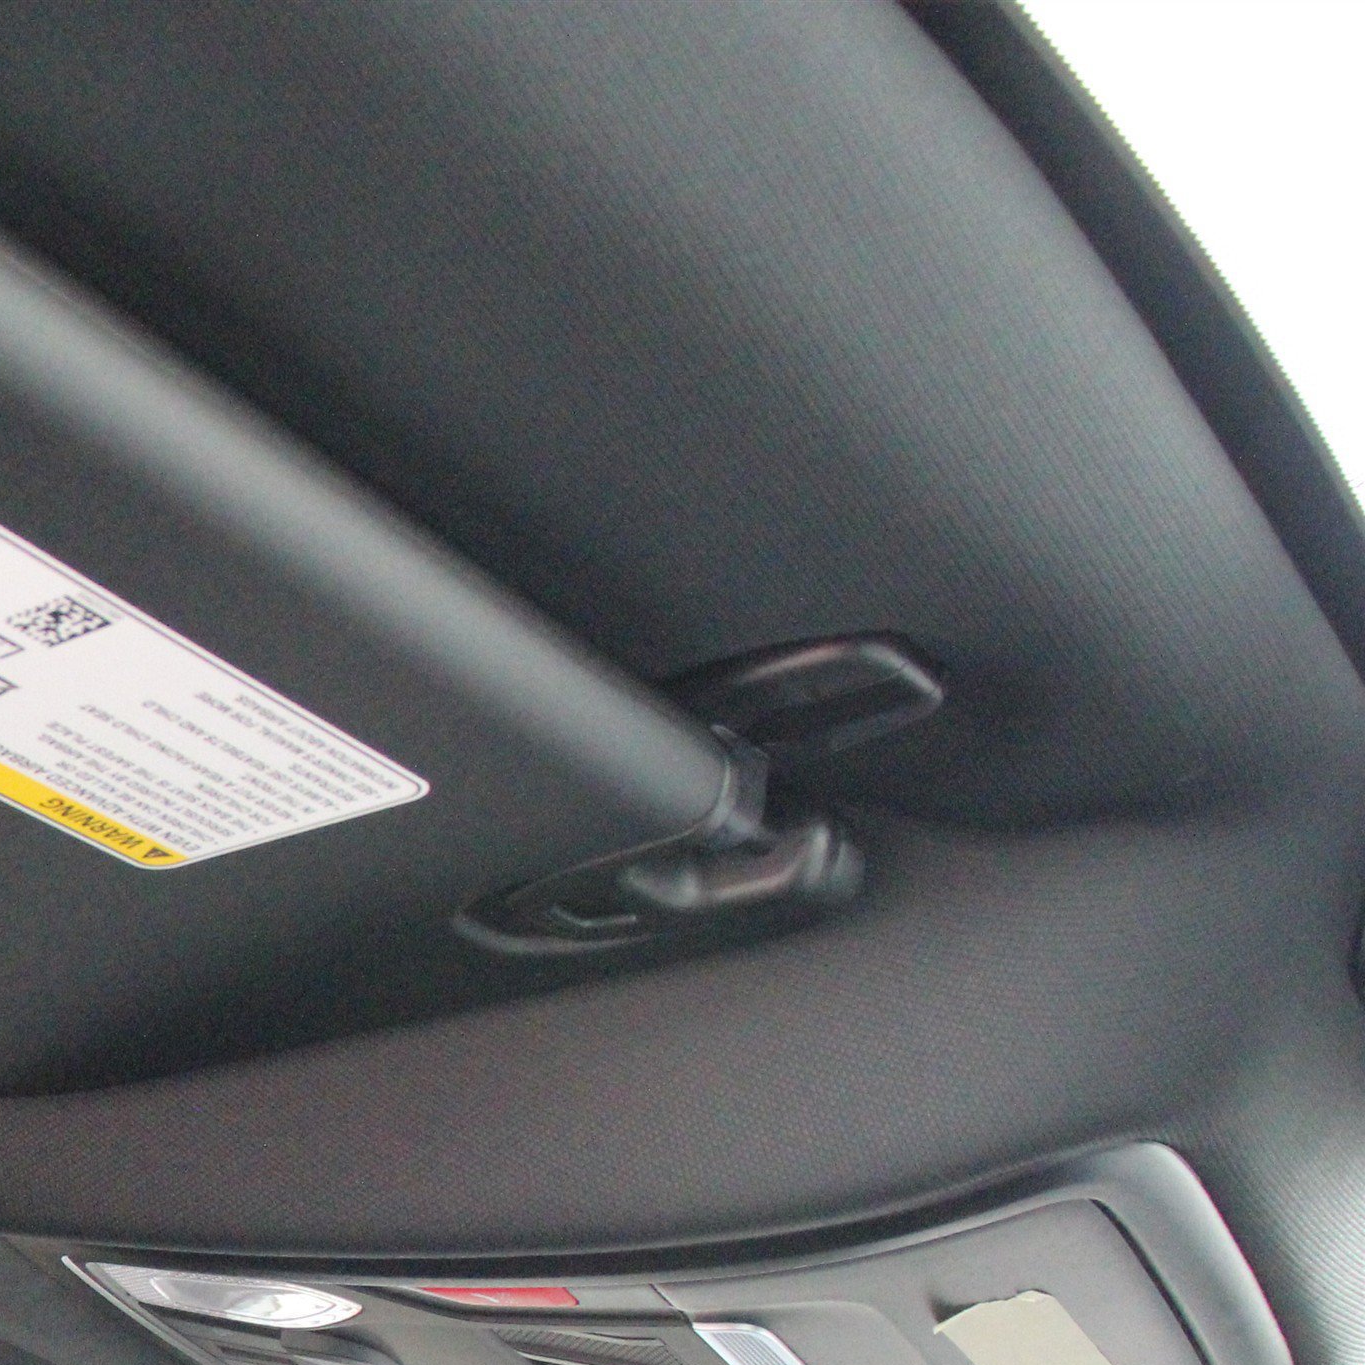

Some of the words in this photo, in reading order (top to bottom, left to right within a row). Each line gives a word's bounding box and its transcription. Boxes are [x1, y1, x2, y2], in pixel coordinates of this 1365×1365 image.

[45, 774, 128, 813] ADVANCED
[41, 797, 145, 846] WARNING
[123, 813, 165, 832] WITH
[158, 831, 202, 850] EVEN
